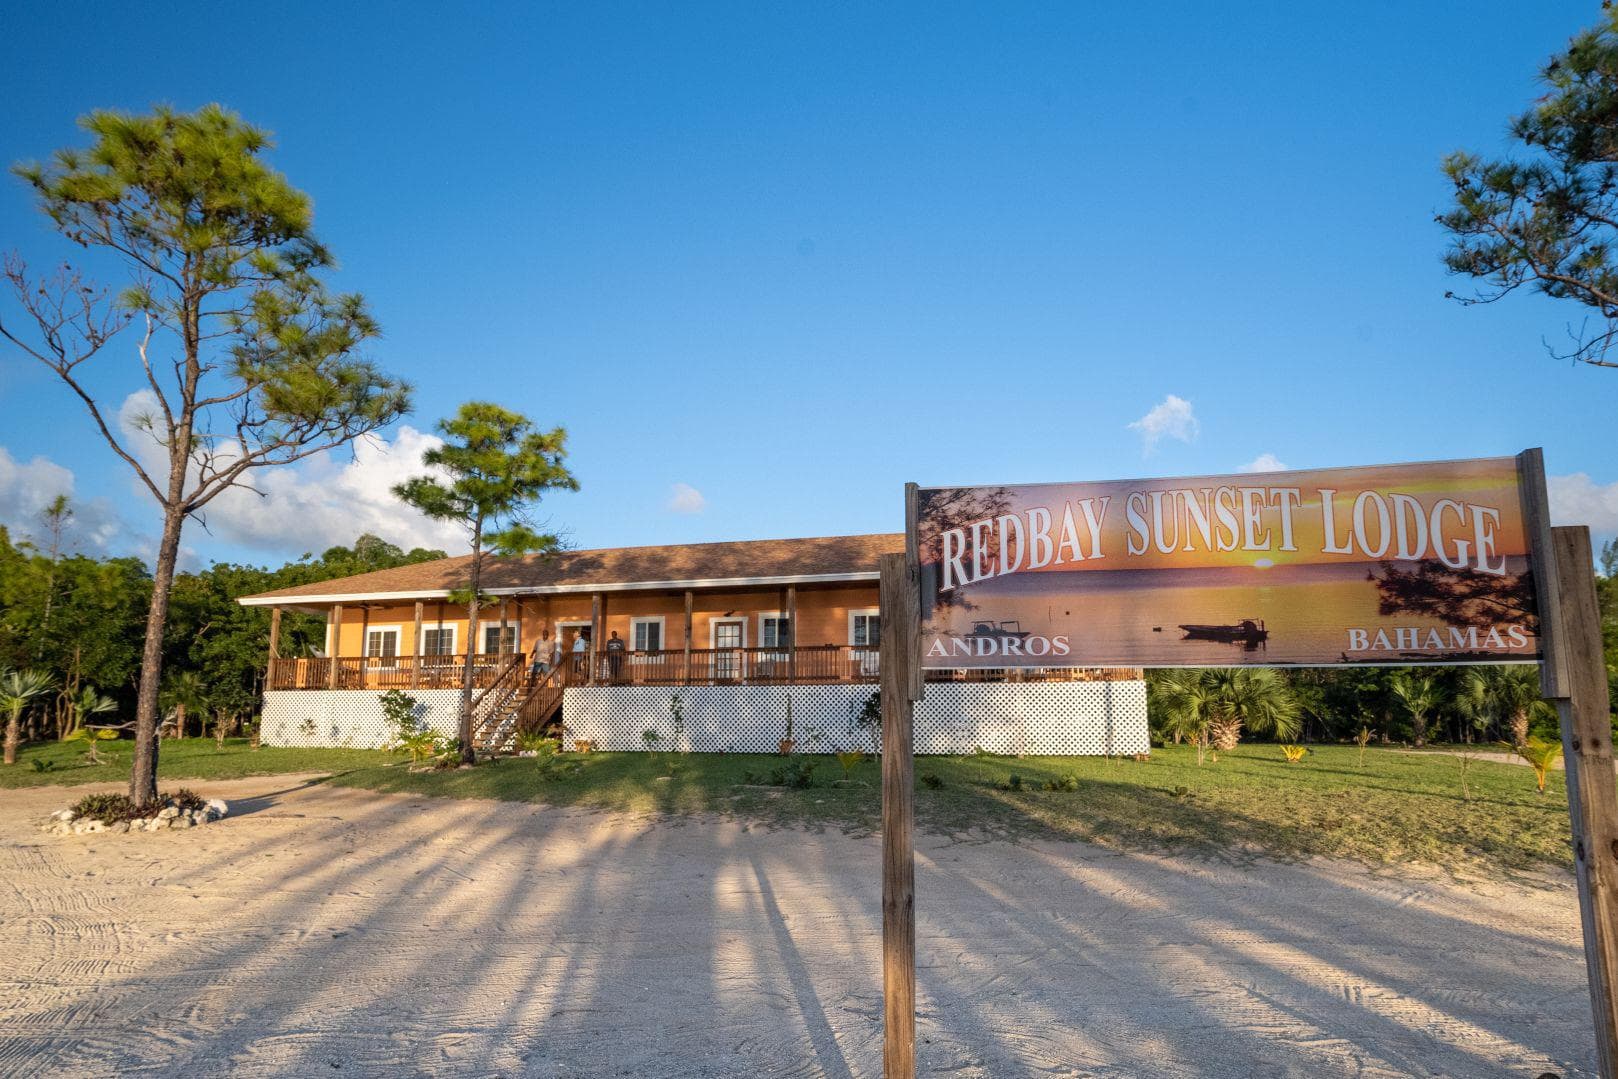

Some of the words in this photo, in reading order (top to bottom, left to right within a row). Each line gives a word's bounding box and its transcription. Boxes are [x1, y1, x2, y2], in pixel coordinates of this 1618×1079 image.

[939, 496, 1112, 593] REDBAY
[1125, 486, 1302, 557] SUNSET
[1317, 488, 1506, 576] LODGE
[926, 635, 1070, 657] ANDROS
[1347, 625, 1529, 651] BAHAMAS
